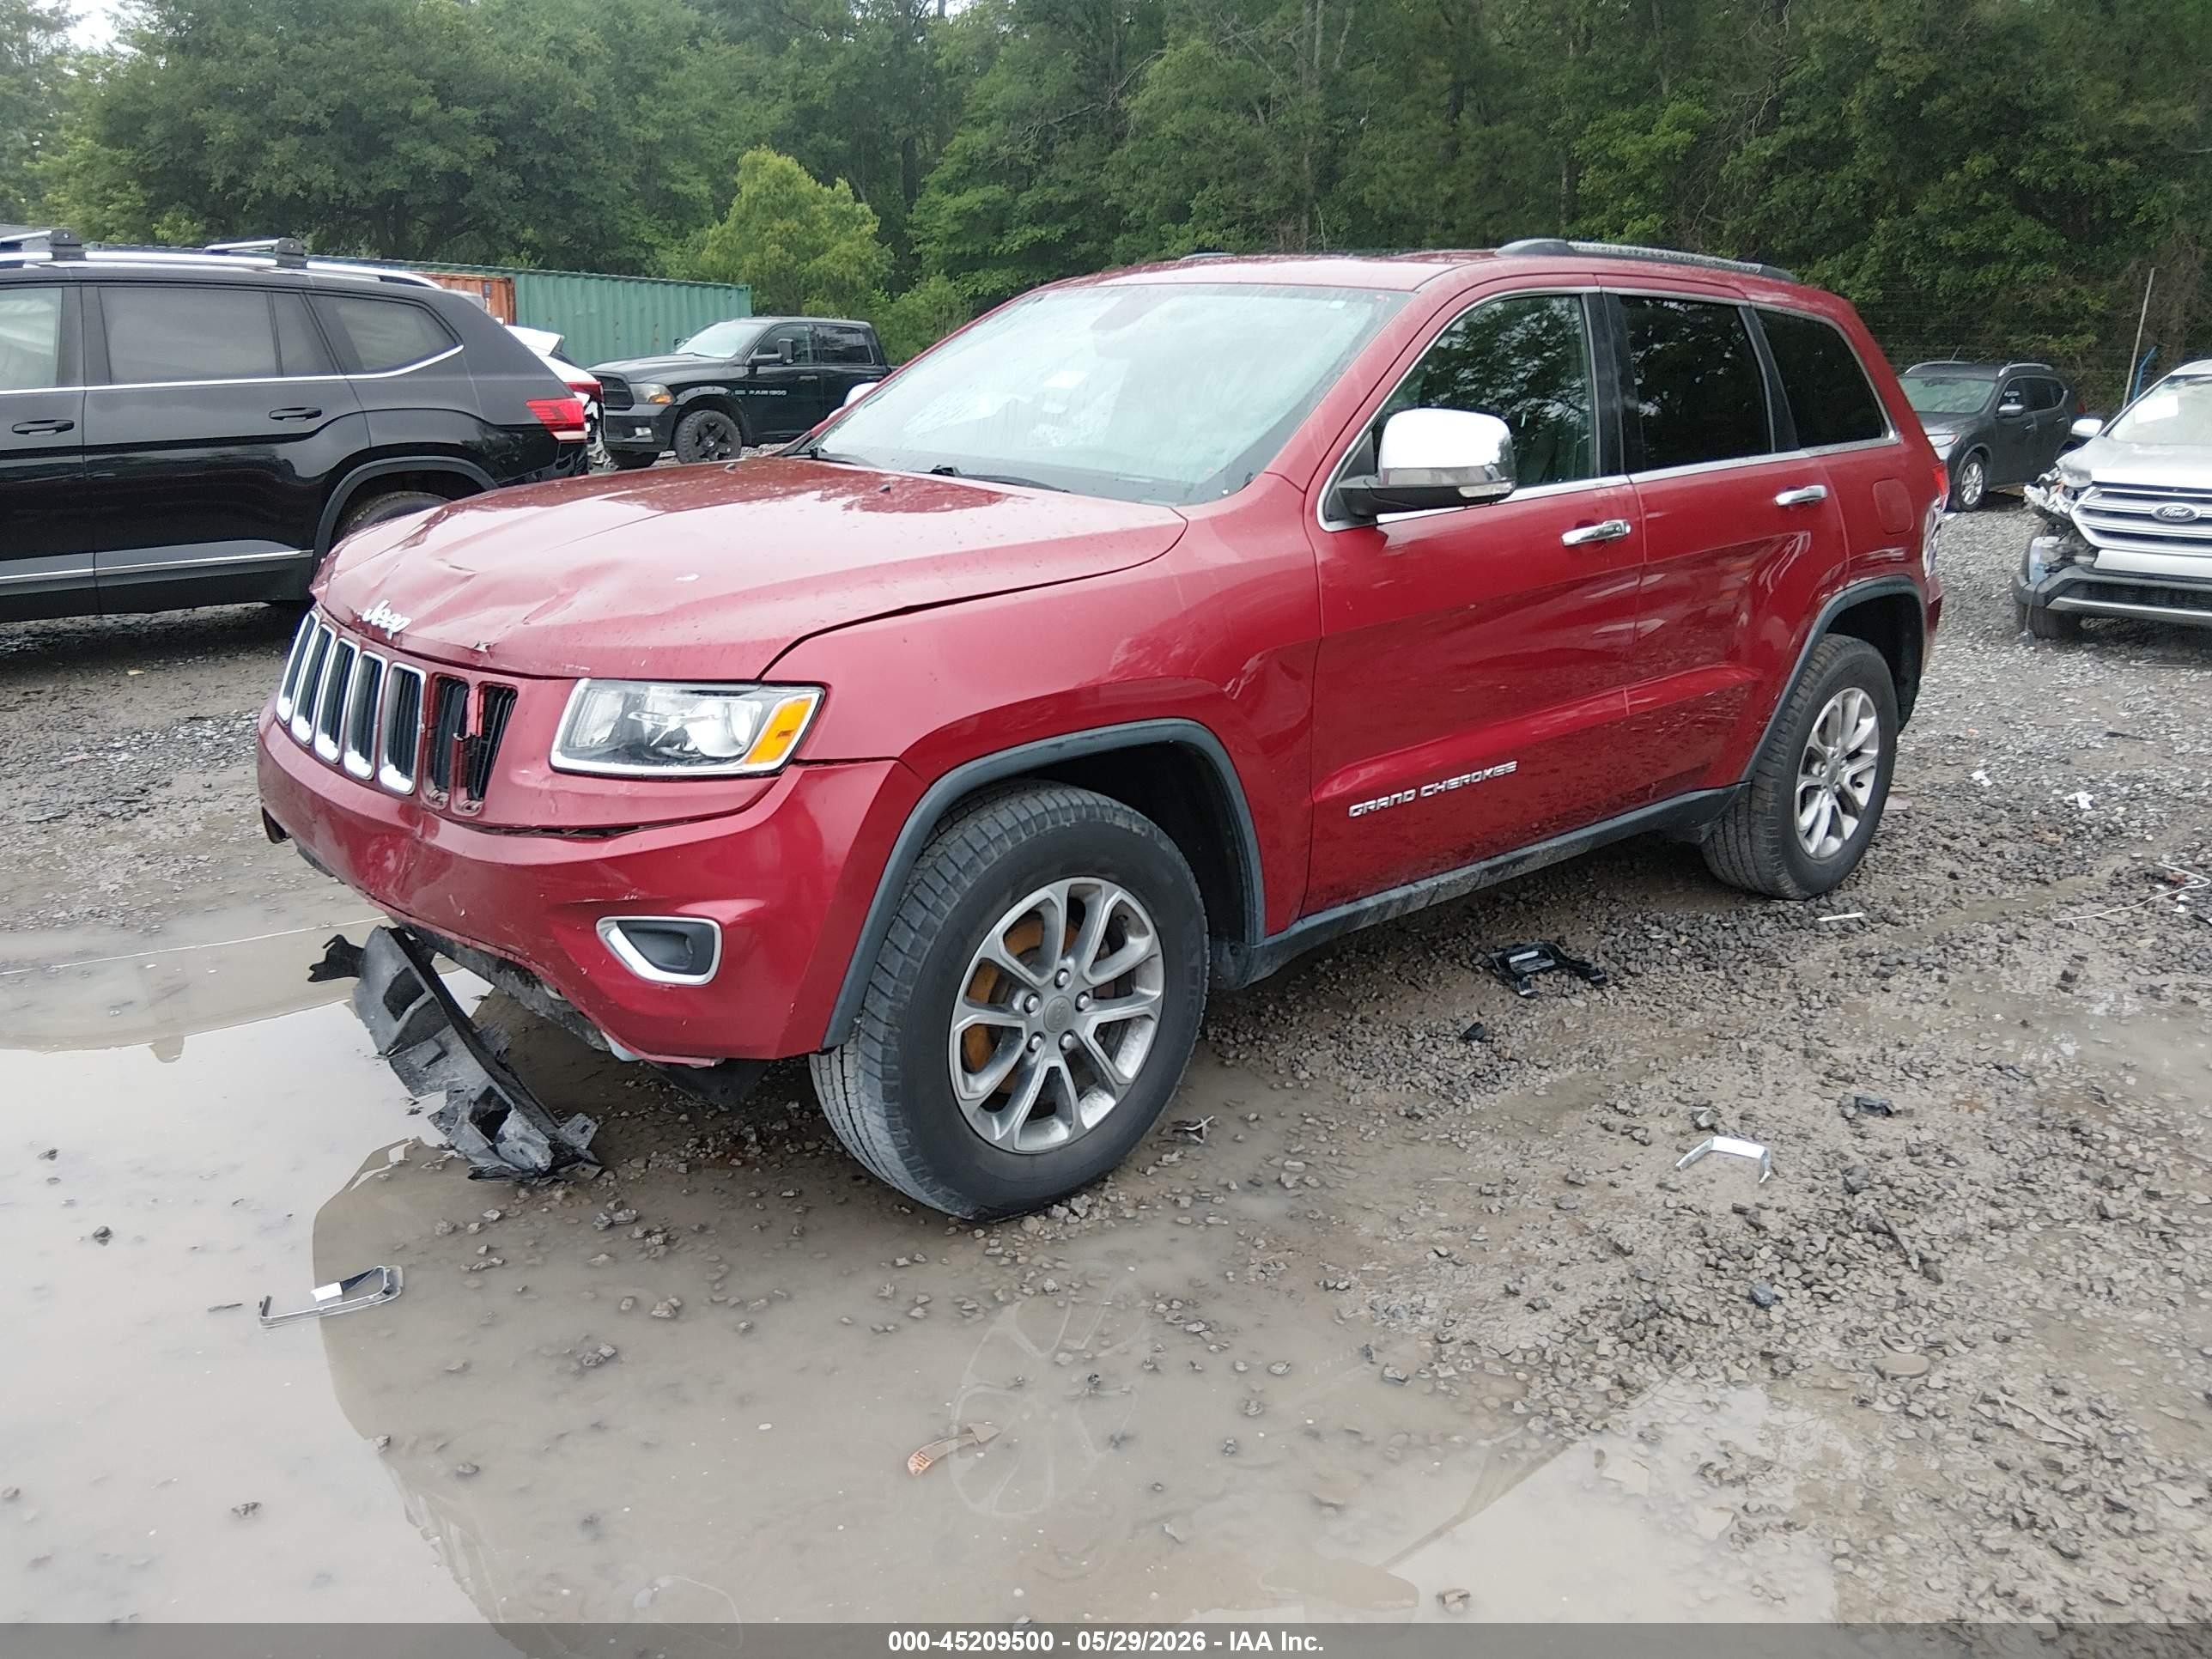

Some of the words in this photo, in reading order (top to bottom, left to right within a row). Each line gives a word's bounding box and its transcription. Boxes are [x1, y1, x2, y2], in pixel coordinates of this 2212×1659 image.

[362, 599, 412, 641] Jeep
[1348, 788, 1416, 817] GRAND
[1420, 761, 1517, 798] CHEROKEE
